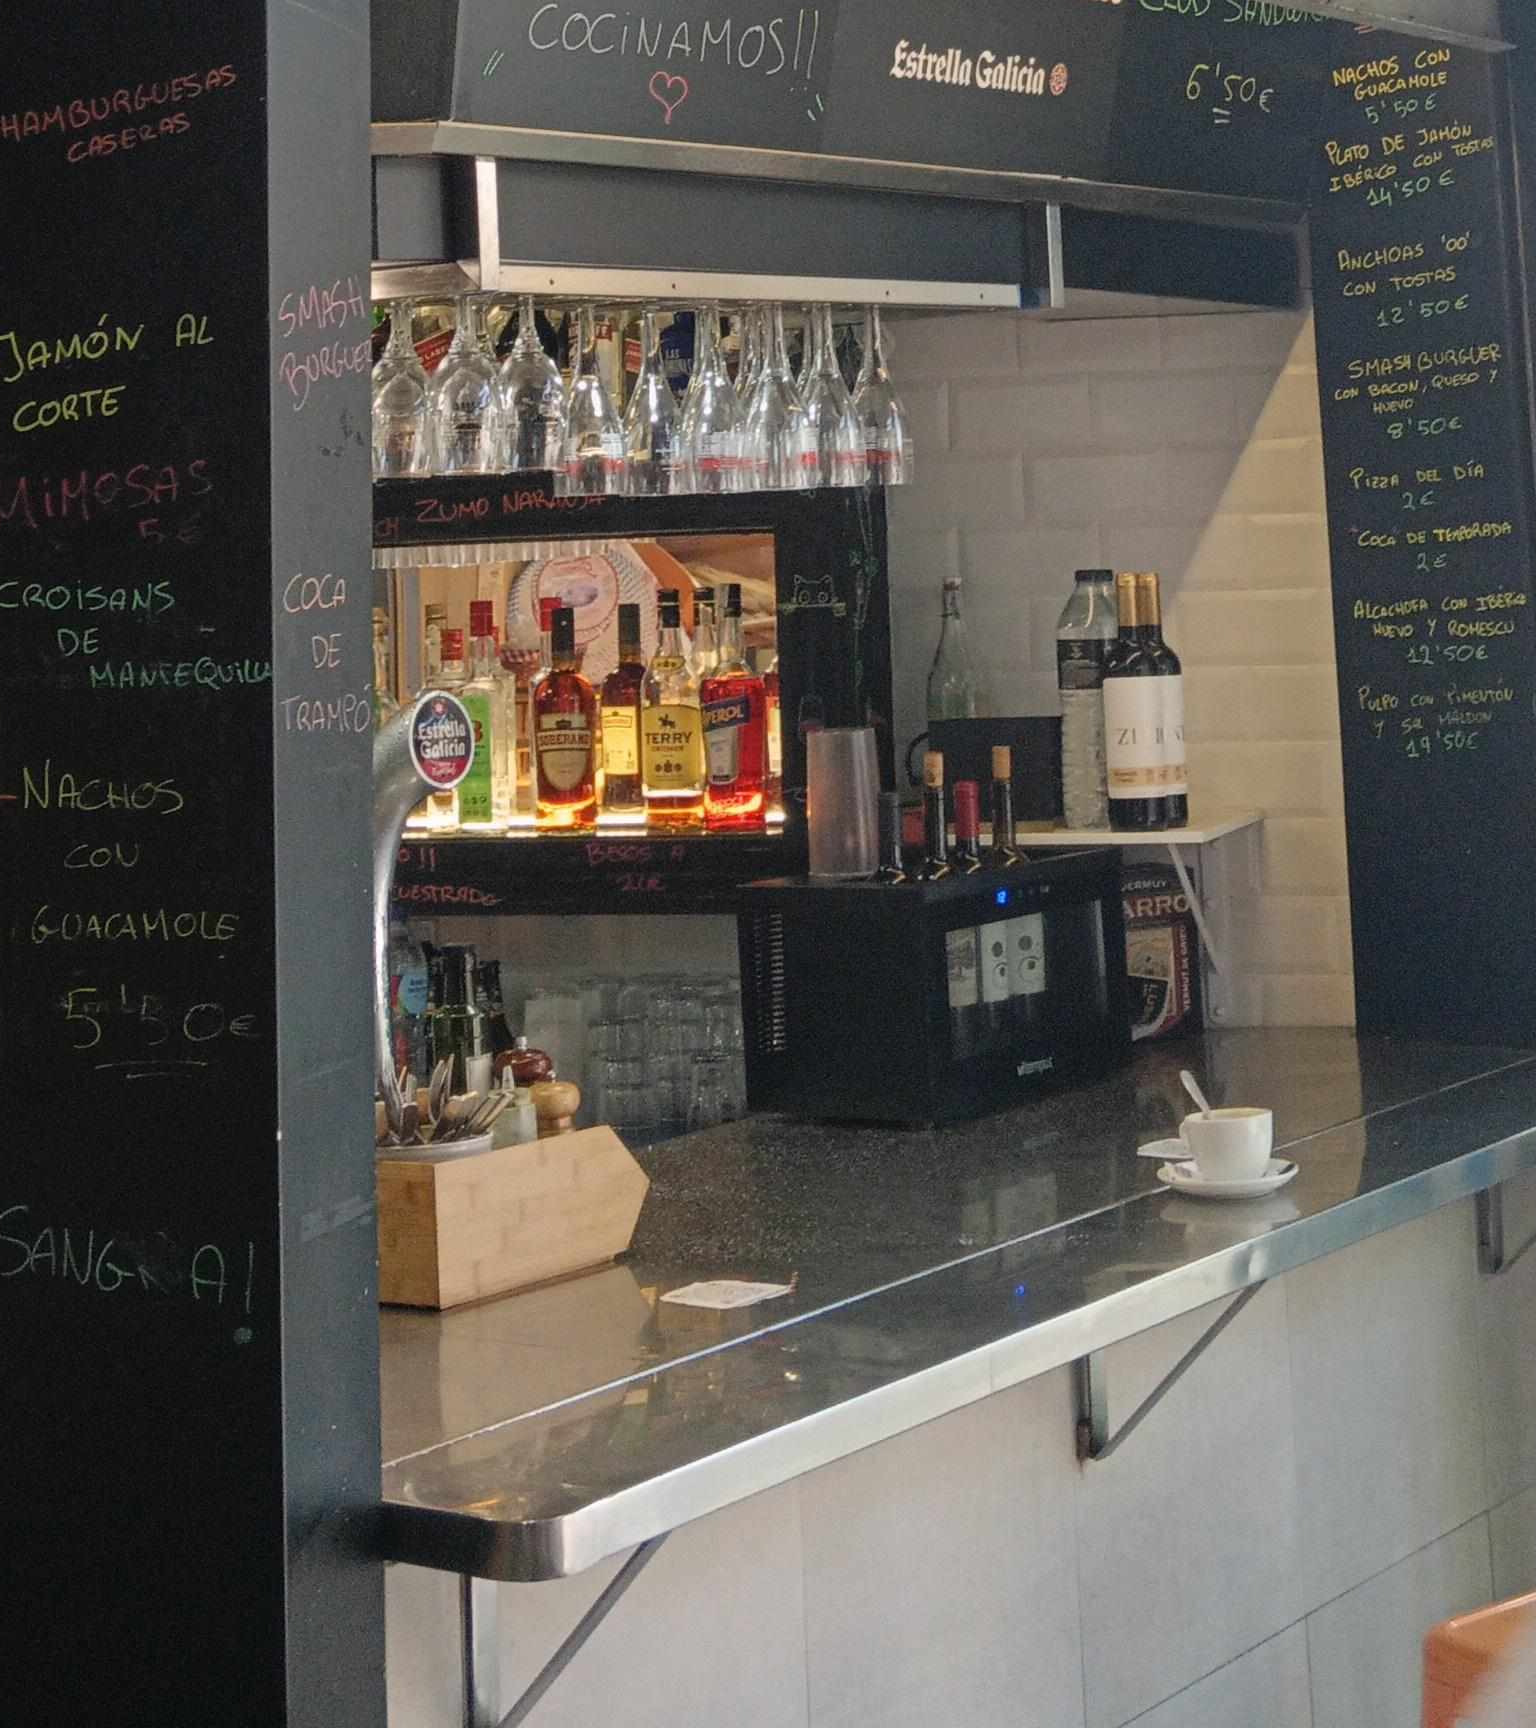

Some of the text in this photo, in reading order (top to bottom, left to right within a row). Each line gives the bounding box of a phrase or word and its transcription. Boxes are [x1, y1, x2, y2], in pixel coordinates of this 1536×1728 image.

[889, 37, 1047, 97] Estrella Galicia
[1332, 48, 1452, 90] NACHOS CON
[1353, 70, 1449, 103] GUACAMOLE
[66, 112, 192, 164] CASERAS
[1325, 139, 1370, 168] PLATO
[1381, 133, 1406, 157] DE
[1412, 149, 1444, 171] CON
[1337, 242, 1425, 273] ANCHOAS
[1342, 265, 1458, 297] CON TOSTAS
[277, 273, 364, 337] SMASH
[175, 312, 216, 348] AL
[1347, 343, 1502, 380] SMASH BURGUER
[1334, 385, 1360, 402] CON
[1431, 372, 1481, 391] QUESO
[12, 384, 127, 433] CORTE
[1372, 397, 1416, 415] HUEVO
[1415, 465, 1443, 484] DEL
[413, 498, 490, 524] ZUMO
[1406, 528, 1428, 546] DE
[282, 572, 349, 615] COCA
[1440, 594, 1470, 612] CON
[57, 625, 100, 658] DE
[311, 631, 344, 670] DE
[417, 720, 466, 740] Estrella
[645, 731, 693, 746] TERRY
[419, 738, 466, 759] Galicia
[63, 841, 140, 871] CON
[31, 904, 241, 944] GUACAMOLE
